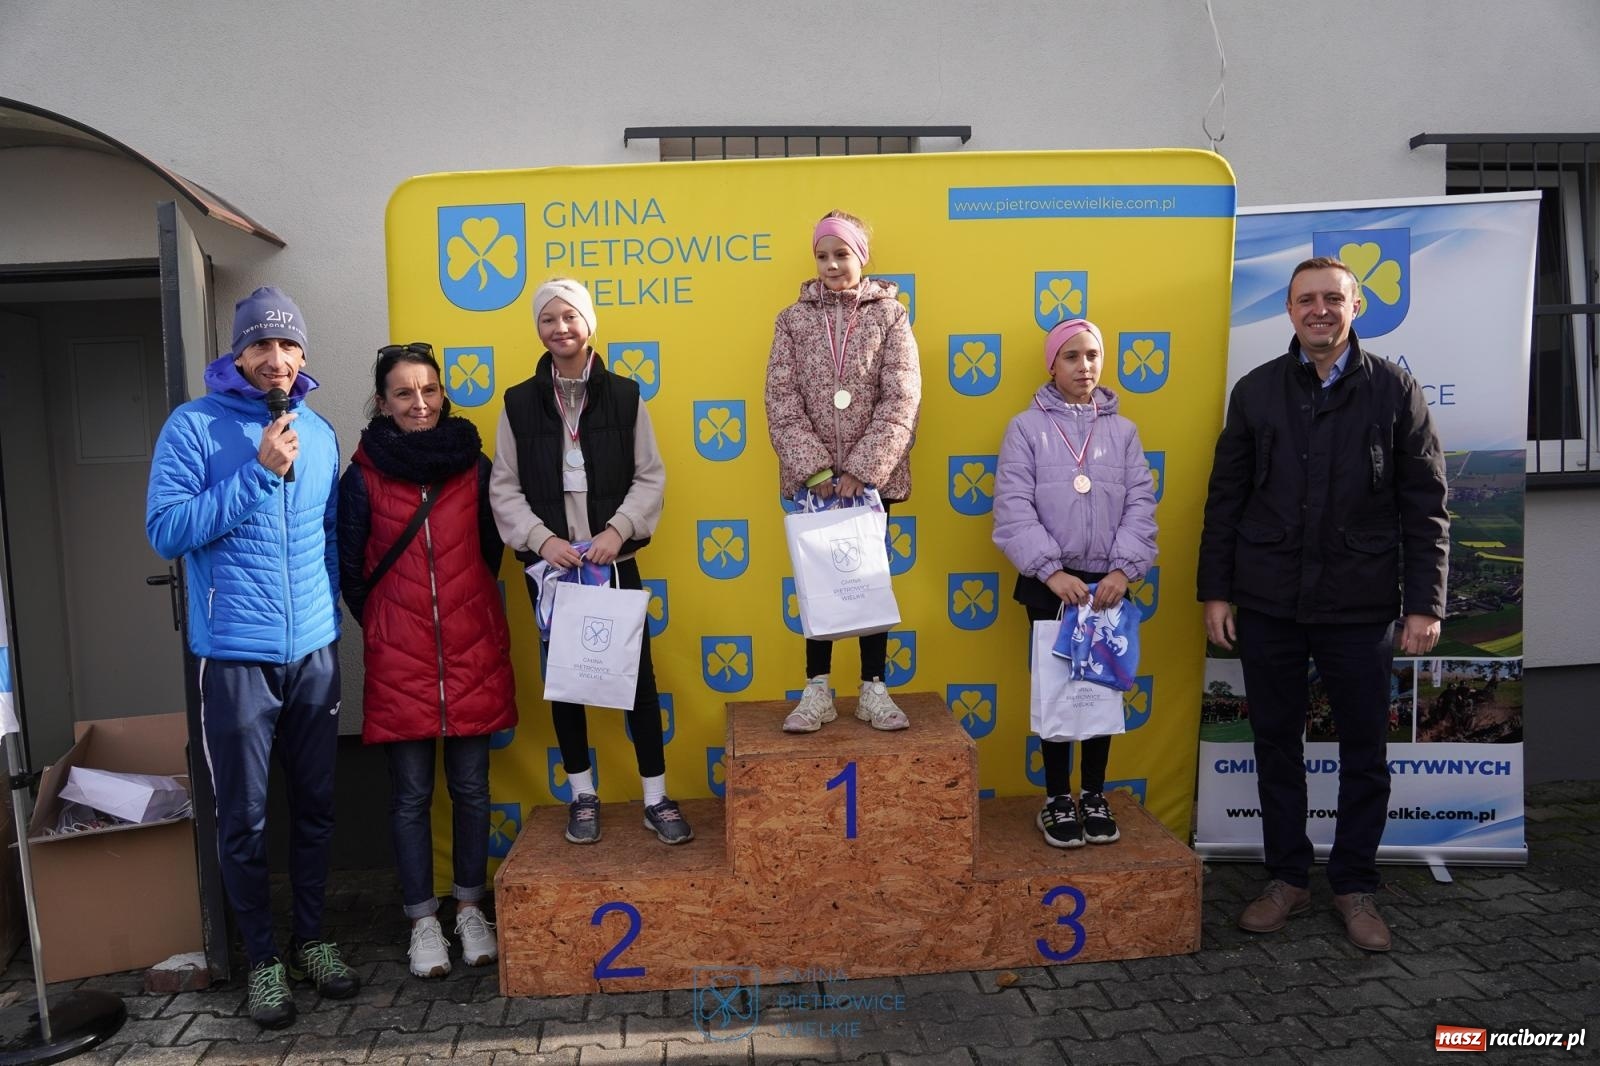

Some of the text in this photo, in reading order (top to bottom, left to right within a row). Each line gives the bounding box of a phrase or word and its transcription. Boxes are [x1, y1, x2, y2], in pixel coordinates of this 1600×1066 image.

[543, 198, 666, 228] GMINA
[954, 196, 1176, 214] www.pietrowicewielkie.com.pl
[545, 234, 772, 268] PIETROWICE
[583, 276, 693, 306] ELKIE
[1386, 759, 1511, 775] KTYWNYCH
[825, 762, 858, 839] 1
[1036, 885, 1087, 962] 3
[590, 902, 646, 979] 2
